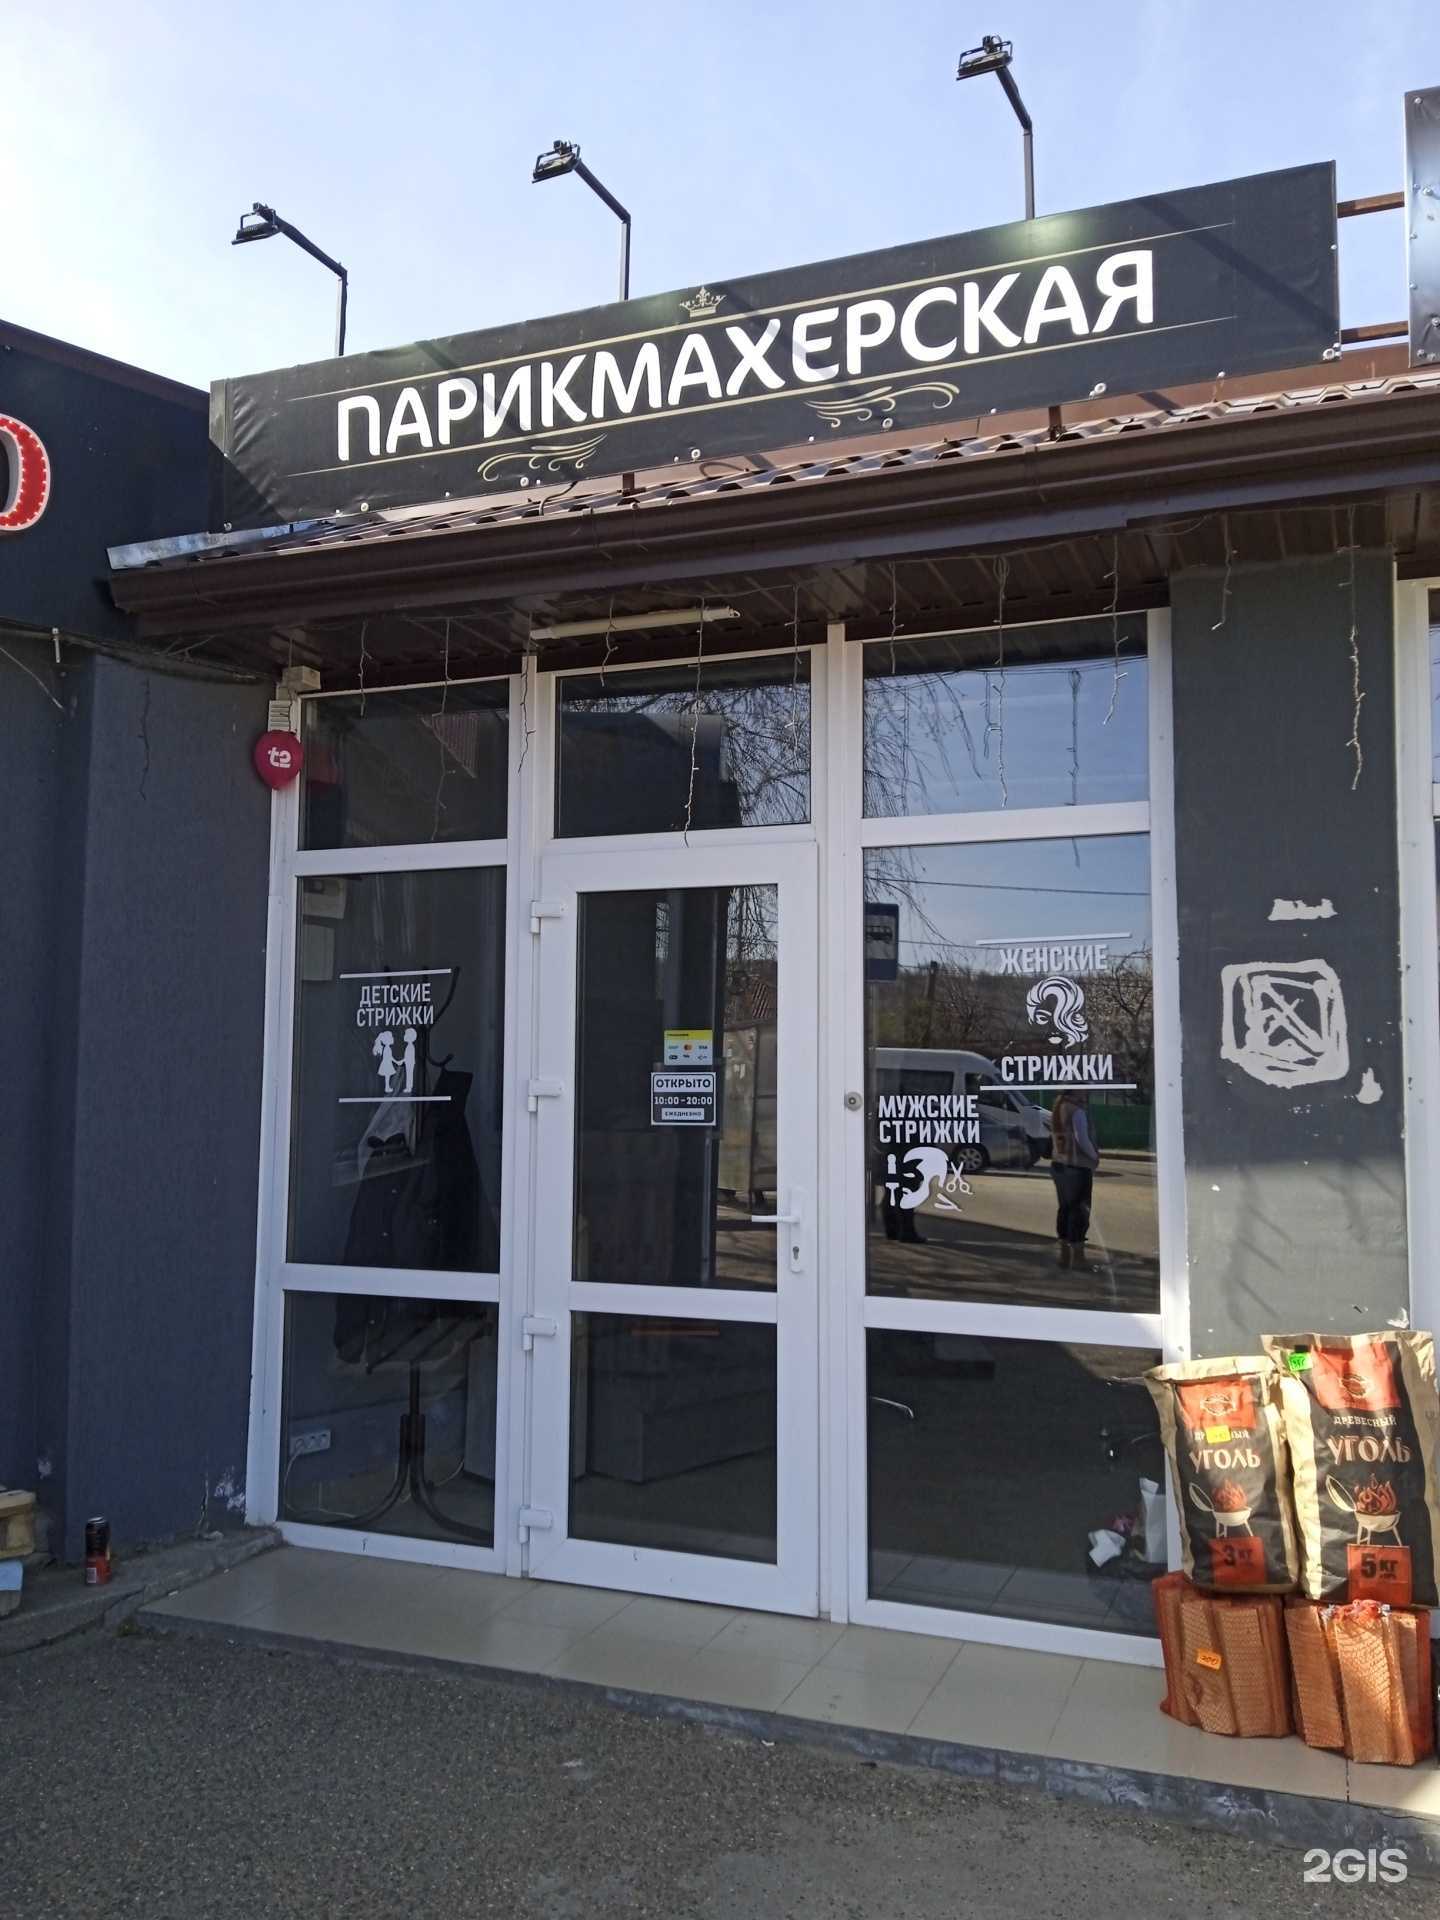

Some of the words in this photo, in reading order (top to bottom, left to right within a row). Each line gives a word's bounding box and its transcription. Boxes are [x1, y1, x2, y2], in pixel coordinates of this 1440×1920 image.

[335, 249, 1154, 462] ПАРИКМАХЕРСКАЯ
[998, 944, 1108, 975] ЖЕНСКИЕ
[359, 983, 431, 1008] ДЕТСКИЕ
[356, 1005, 434, 1027] СТРИЖКИ
[1000, 1054, 1114, 1082] СТРИЖКИ
[656, 1079, 711, 1088] ОТКРЫТО
[878, 1094, 979, 1118] МУЖСКИЕ
[879, 1120, 981, 1144] СТРИЖКИ
[1333, 1414, 1397, 1428] ДРЕВЕСНЫЙ
[1188, 1448, 1261, 1475] УГОЛЬ
[1327, 1435, 1411, 1466] УГОЛЬ
[1223, 1545, 1236, 1567] 3
[1361, 1552, 1377, 1579] 5
